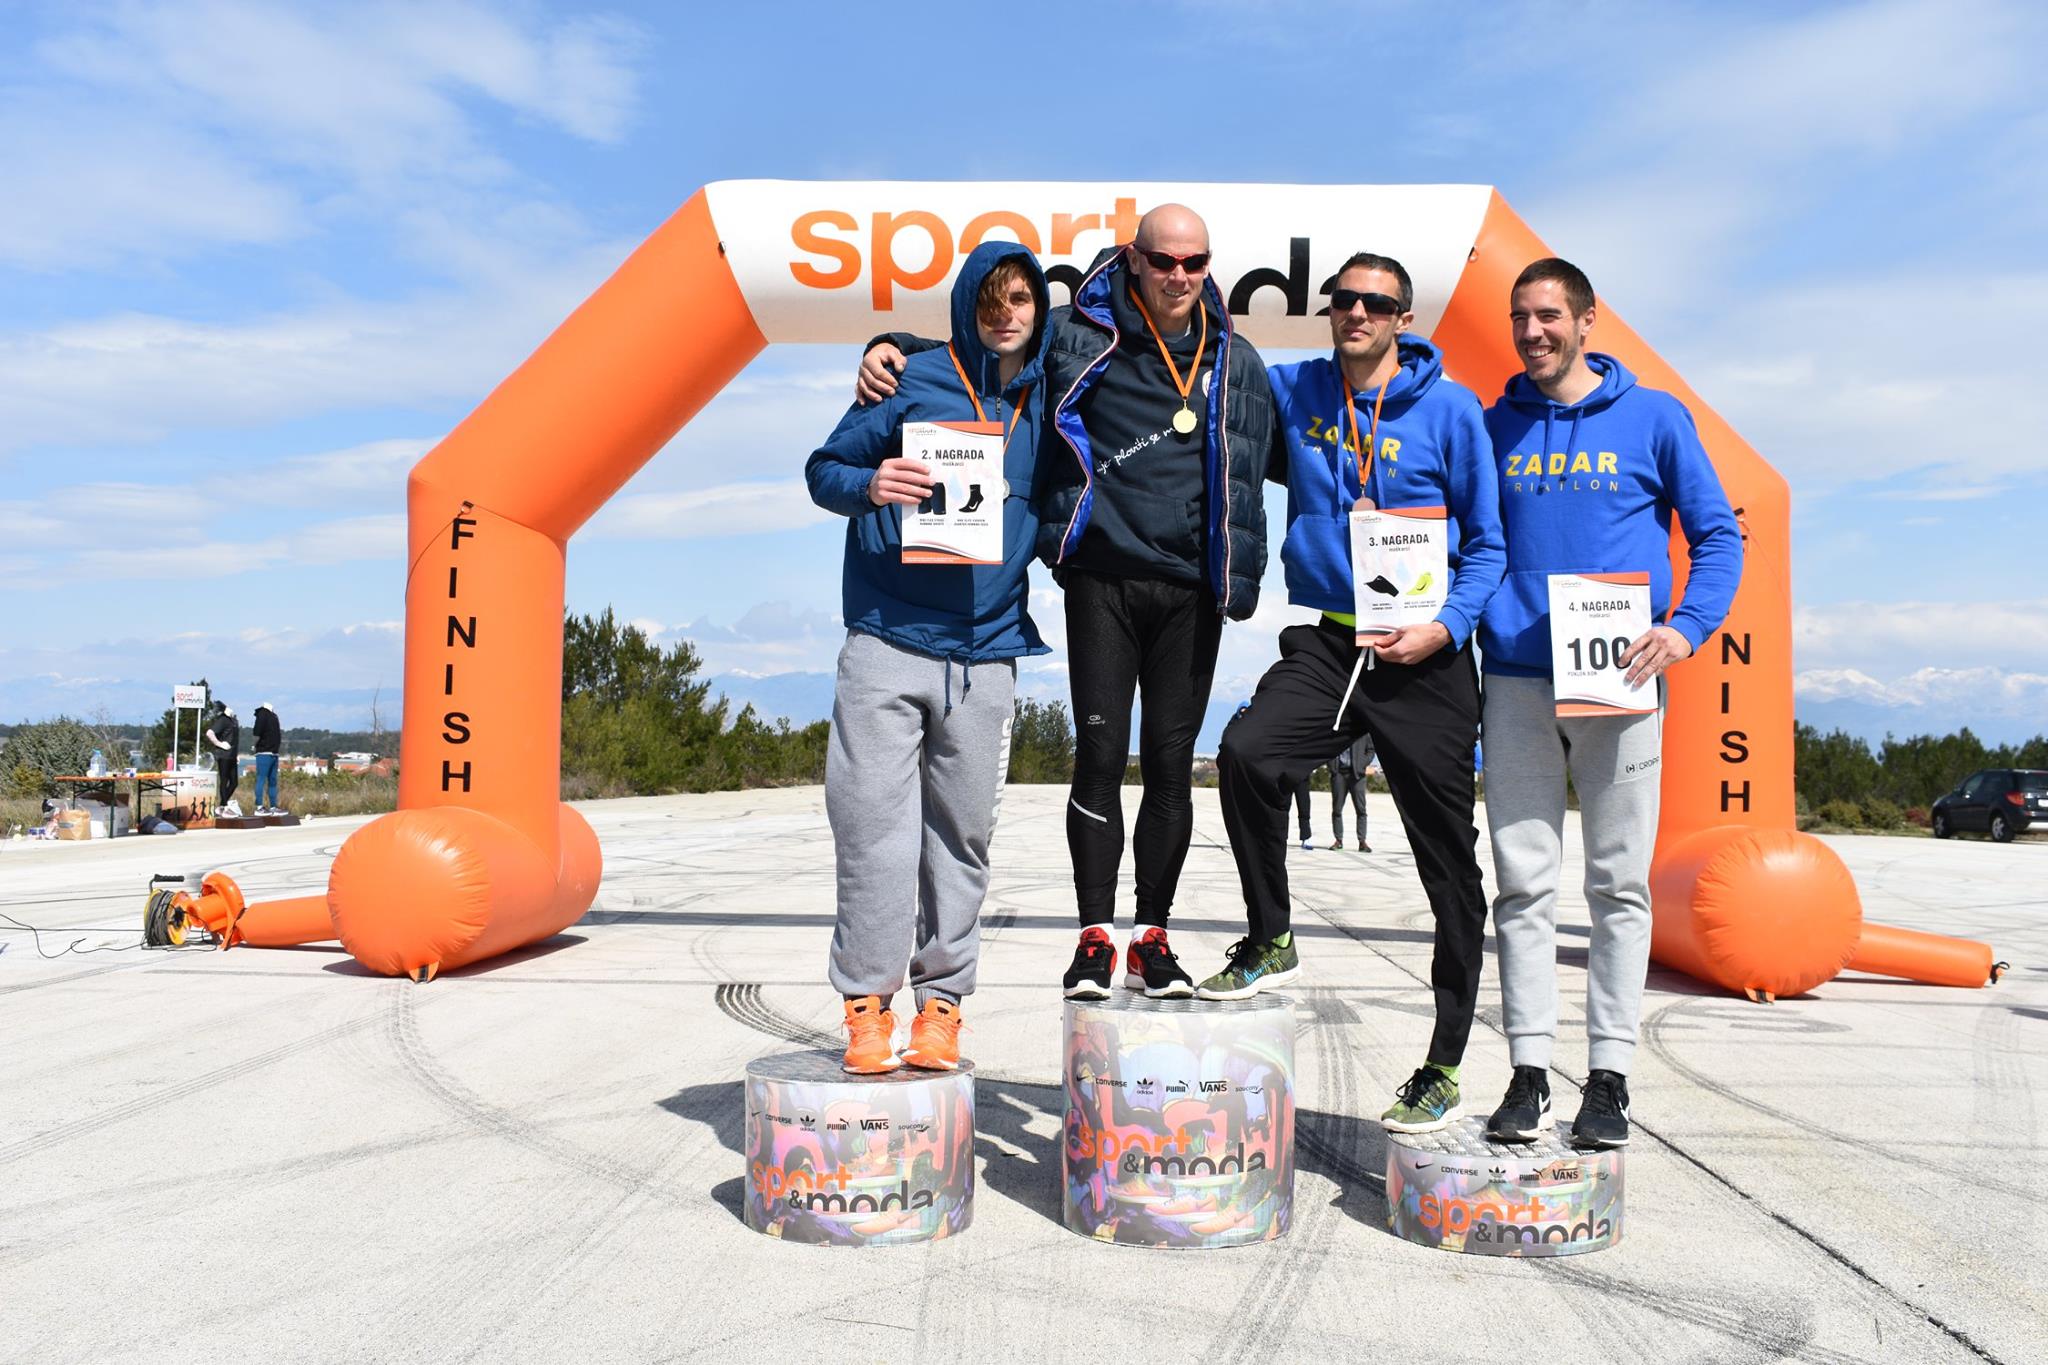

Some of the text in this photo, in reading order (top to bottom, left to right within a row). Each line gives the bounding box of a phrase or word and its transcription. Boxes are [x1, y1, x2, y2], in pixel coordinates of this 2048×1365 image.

[921, 449, 984, 460] 2. NAGRADA
[1505, 451, 1618, 476] ZADAR
[1369, 533, 1429, 546] 3. NAGRADA
[1569, 600, 1631, 612] 4. NAGRADA
[442, 518, 477, 792] FINISH
[1567, 636, 1632, 671] 100
[1095, 1077, 1127, 1087] CONVERSE
[1199, 1080, 1227, 1093] VANS
[860, 1118, 889, 1130] VANS
[1079, 1126, 1192, 1169] sport
[1441, 1166, 1479, 1176] CONVERSE
[1552, 1168, 1579, 1181] VANS
[753, 1160, 852, 1210] sport
[1418, 1194, 1545, 1238] sport
